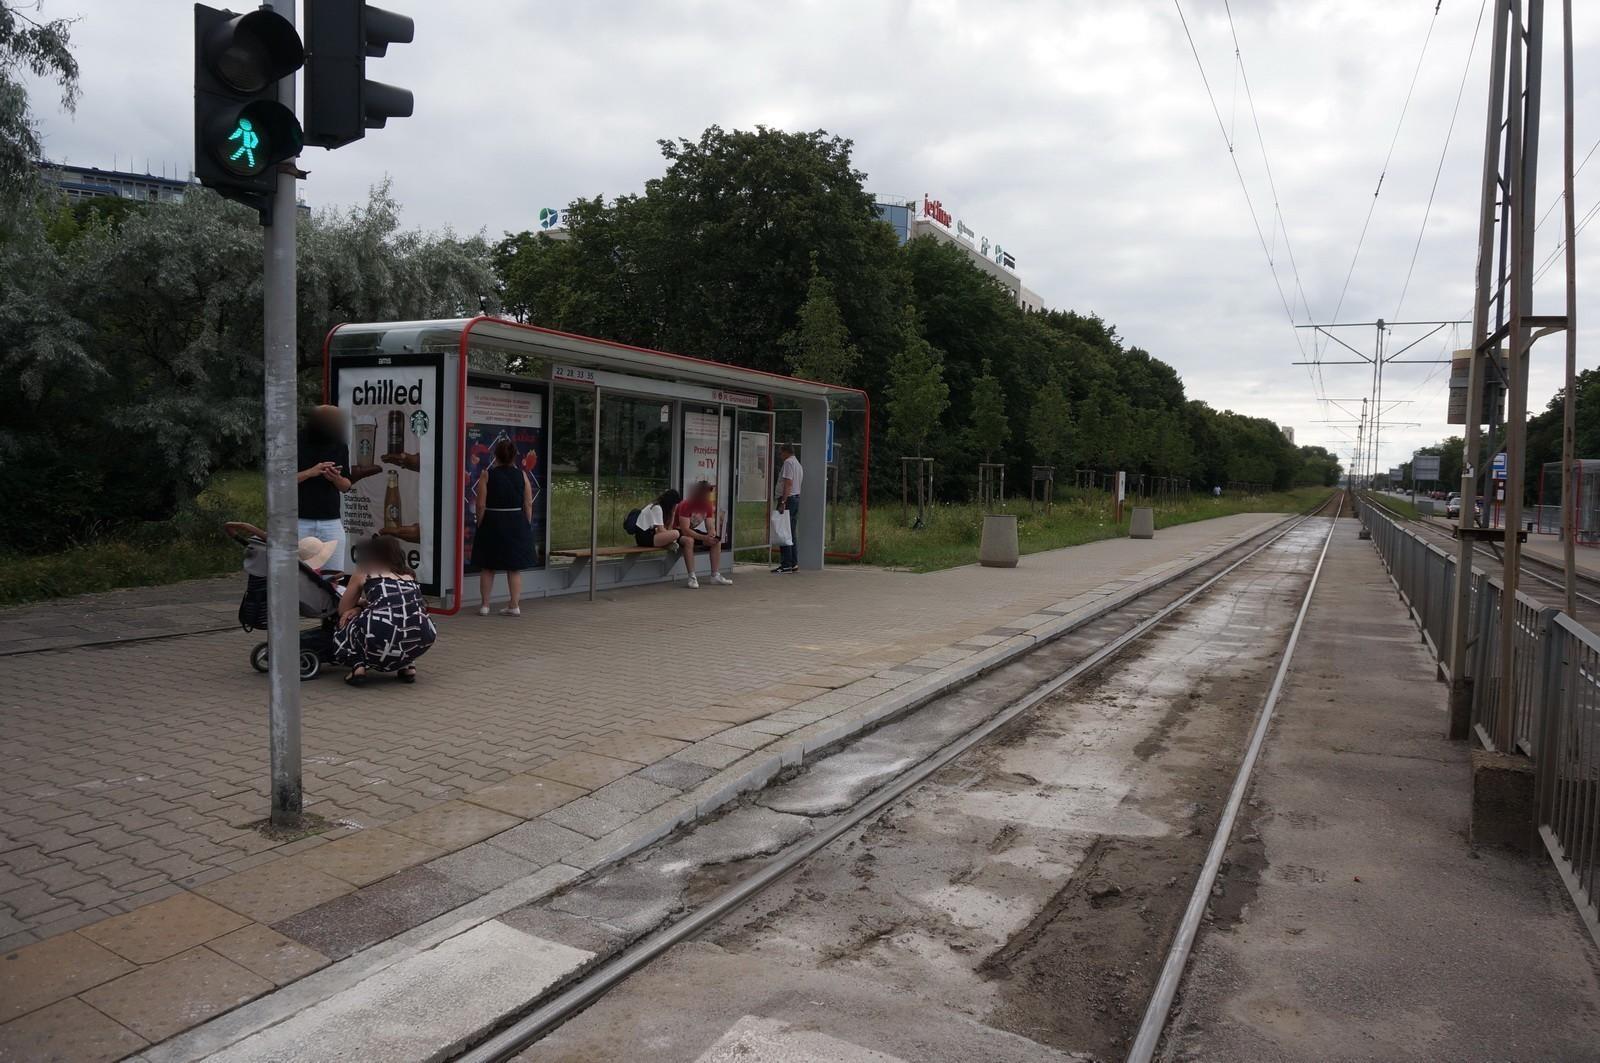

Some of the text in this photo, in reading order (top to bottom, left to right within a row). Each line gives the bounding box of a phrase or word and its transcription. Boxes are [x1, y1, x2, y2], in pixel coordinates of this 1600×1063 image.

[924, 193, 952, 229] jetline
[556, 367, 564, 376] 22
[352, 379, 423, 406] chilled
[705, 458, 716, 469] TY
